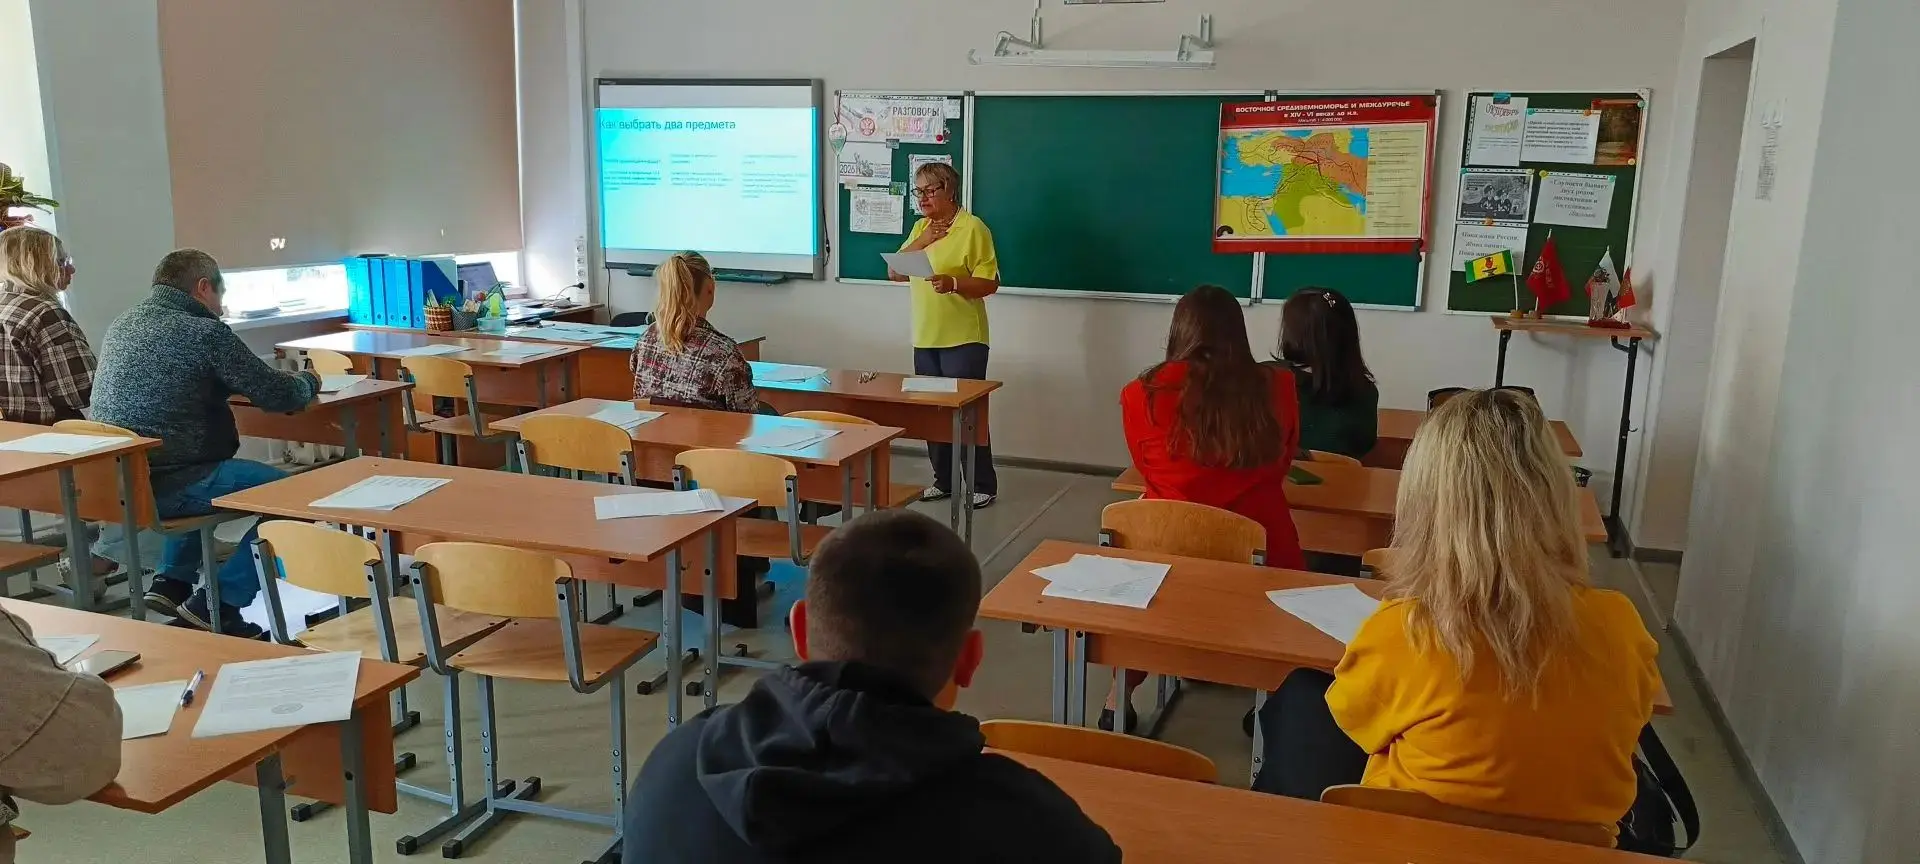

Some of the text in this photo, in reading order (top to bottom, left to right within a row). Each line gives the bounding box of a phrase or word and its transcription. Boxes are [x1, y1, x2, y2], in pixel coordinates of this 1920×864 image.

[1277, 103, 1349, 111] СРЕДИЗЕМНОМОРЬЕ
[1359, 100, 1411, 108] МЕЖДУРЕЧЬЕ
[892, 106, 940, 117] РАЗГОВОРЫ
[619, 118, 662, 131] выбрать
[664, 121, 683, 131] два
[686, 120, 736, 131] предмета
